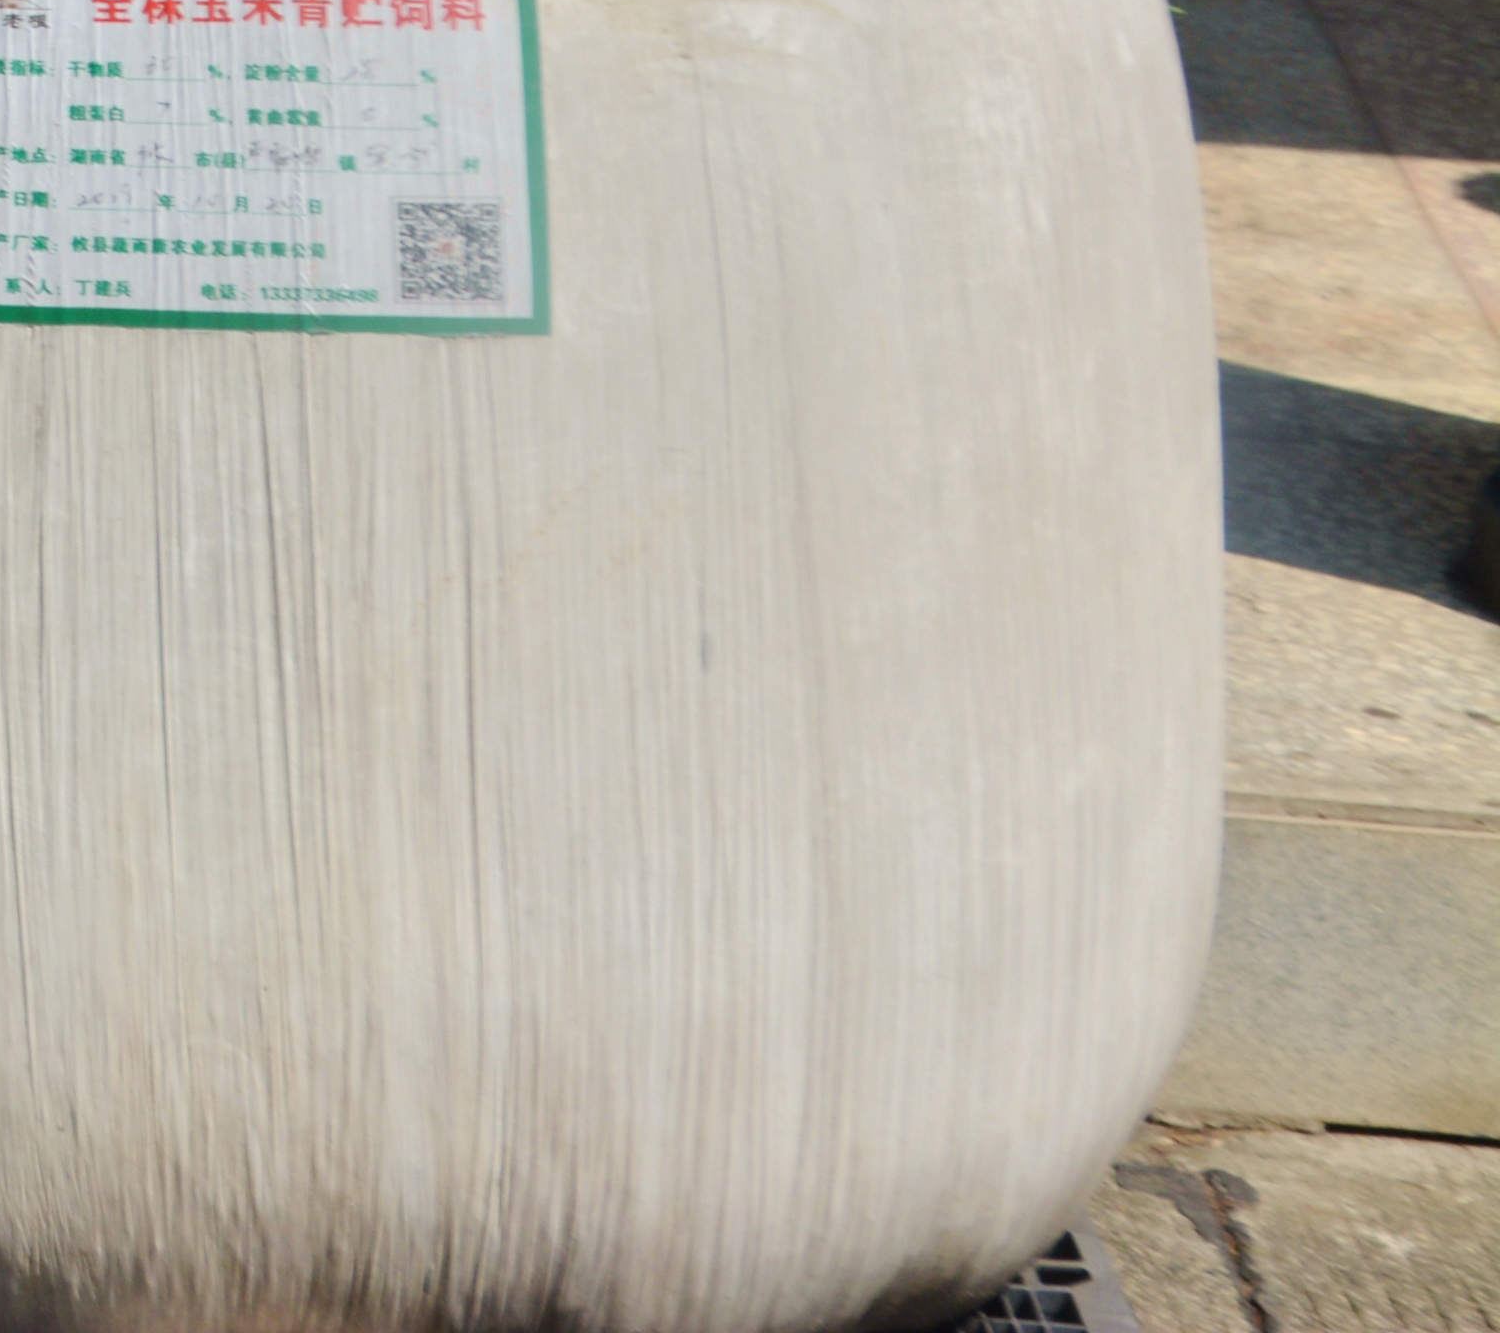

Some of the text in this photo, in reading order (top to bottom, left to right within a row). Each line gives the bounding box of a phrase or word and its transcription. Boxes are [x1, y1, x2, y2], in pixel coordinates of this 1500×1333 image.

[67, 60, 123, 78] 干物质
[70, 148, 127, 166] 湖南省
[233, 195, 249, 213] 月
[308, 198, 323, 215] 日
